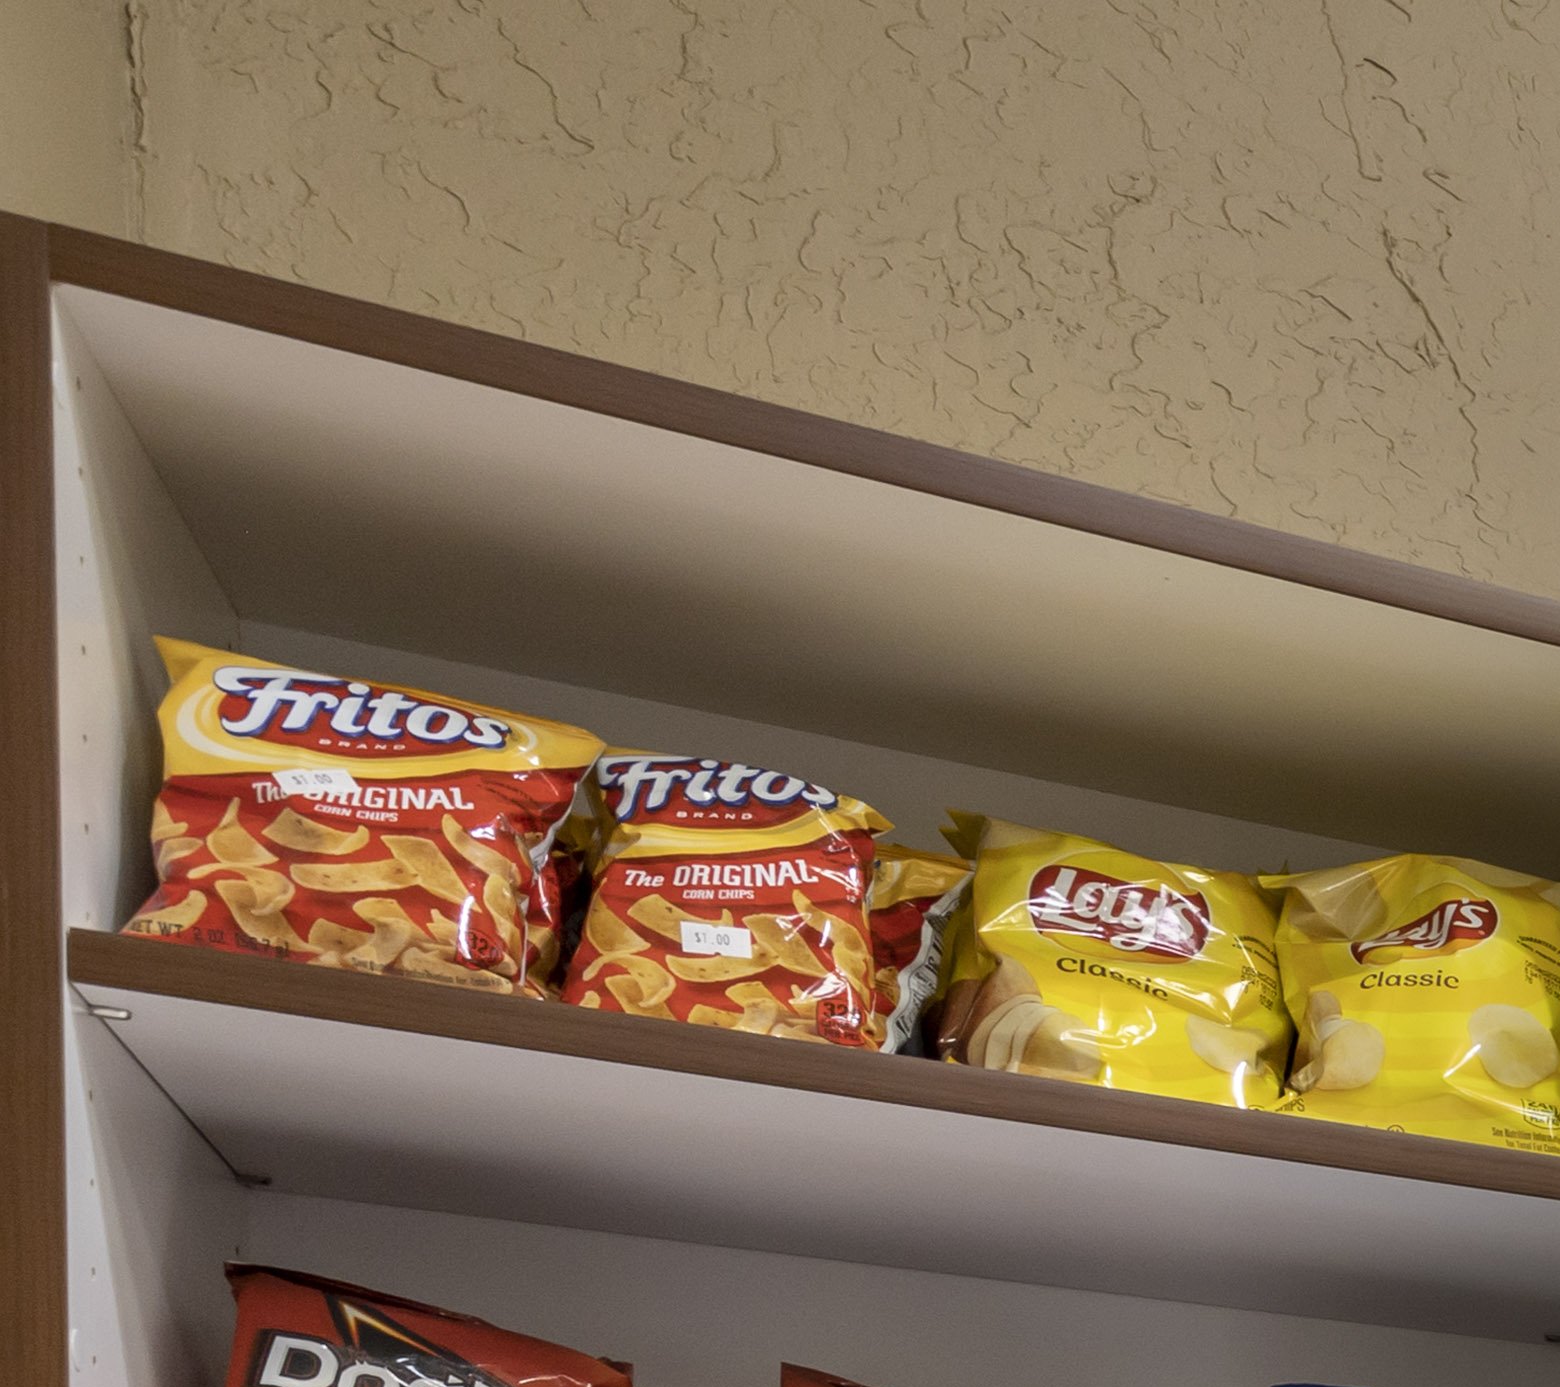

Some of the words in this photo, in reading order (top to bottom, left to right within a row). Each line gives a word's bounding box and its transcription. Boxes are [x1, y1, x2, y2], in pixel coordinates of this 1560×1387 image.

[213, 666, 511, 749] Fritos
[319, 739, 406, 751] BRAND
[292, 773, 333, 786] $1.00
[598, 756, 838, 822] Fritos
[314, 804, 352, 818] CORN
[356, 810, 398, 822] CHIPS
[676, 811, 752, 820] BRAND
[625, 869, 664, 887] The
[673, 860, 819, 888] ORIGINAL
[682, 889, 716, 900] CORN
[719, 889, 754, 900] CHIPS
[1036, 866, 1198, 953] Lay's
[695, 931, 730, 946] $1.00
[1056, 956, 1169, 1003] Classic
[1360, 970, 1460, 992] Classic
